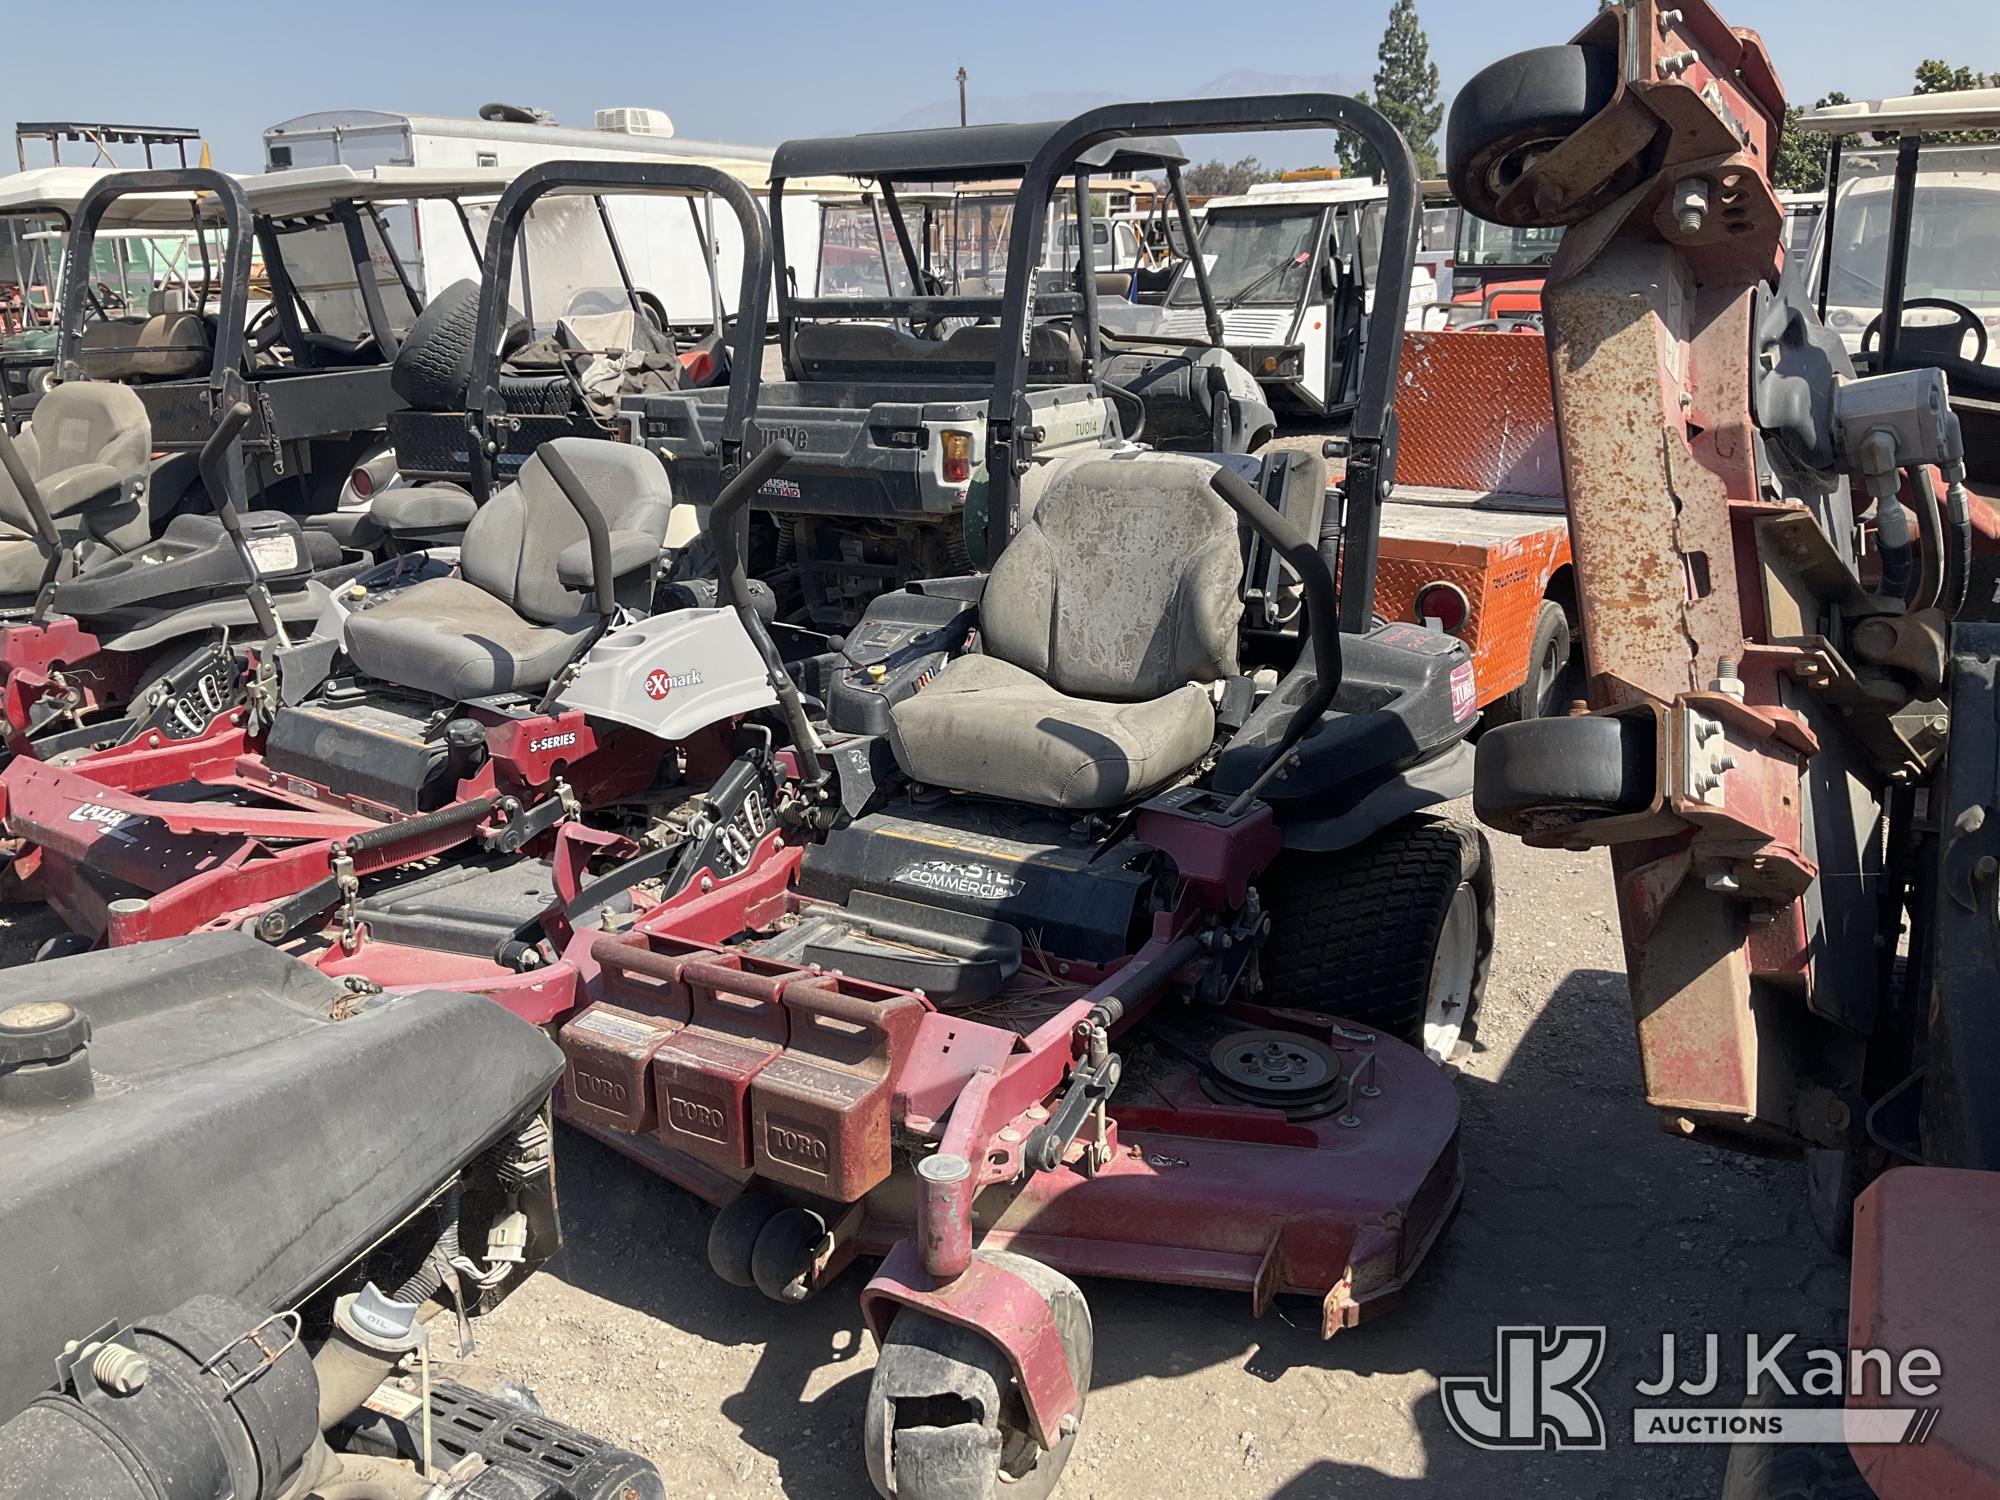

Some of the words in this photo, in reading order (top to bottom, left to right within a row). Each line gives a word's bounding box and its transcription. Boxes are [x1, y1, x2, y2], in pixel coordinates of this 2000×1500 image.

[644, 668, 703, 696] eXmark
[529, 731, 577, 754] S-SERIES
[67, 802, 127, 828] LAZER
[578, 1071, 628, 1101] TORO
[672, 1096, 725, 1129] TORO
[770, 1125, 827, 1159] TORO
[366, 1314, 389, 1330] OIL
